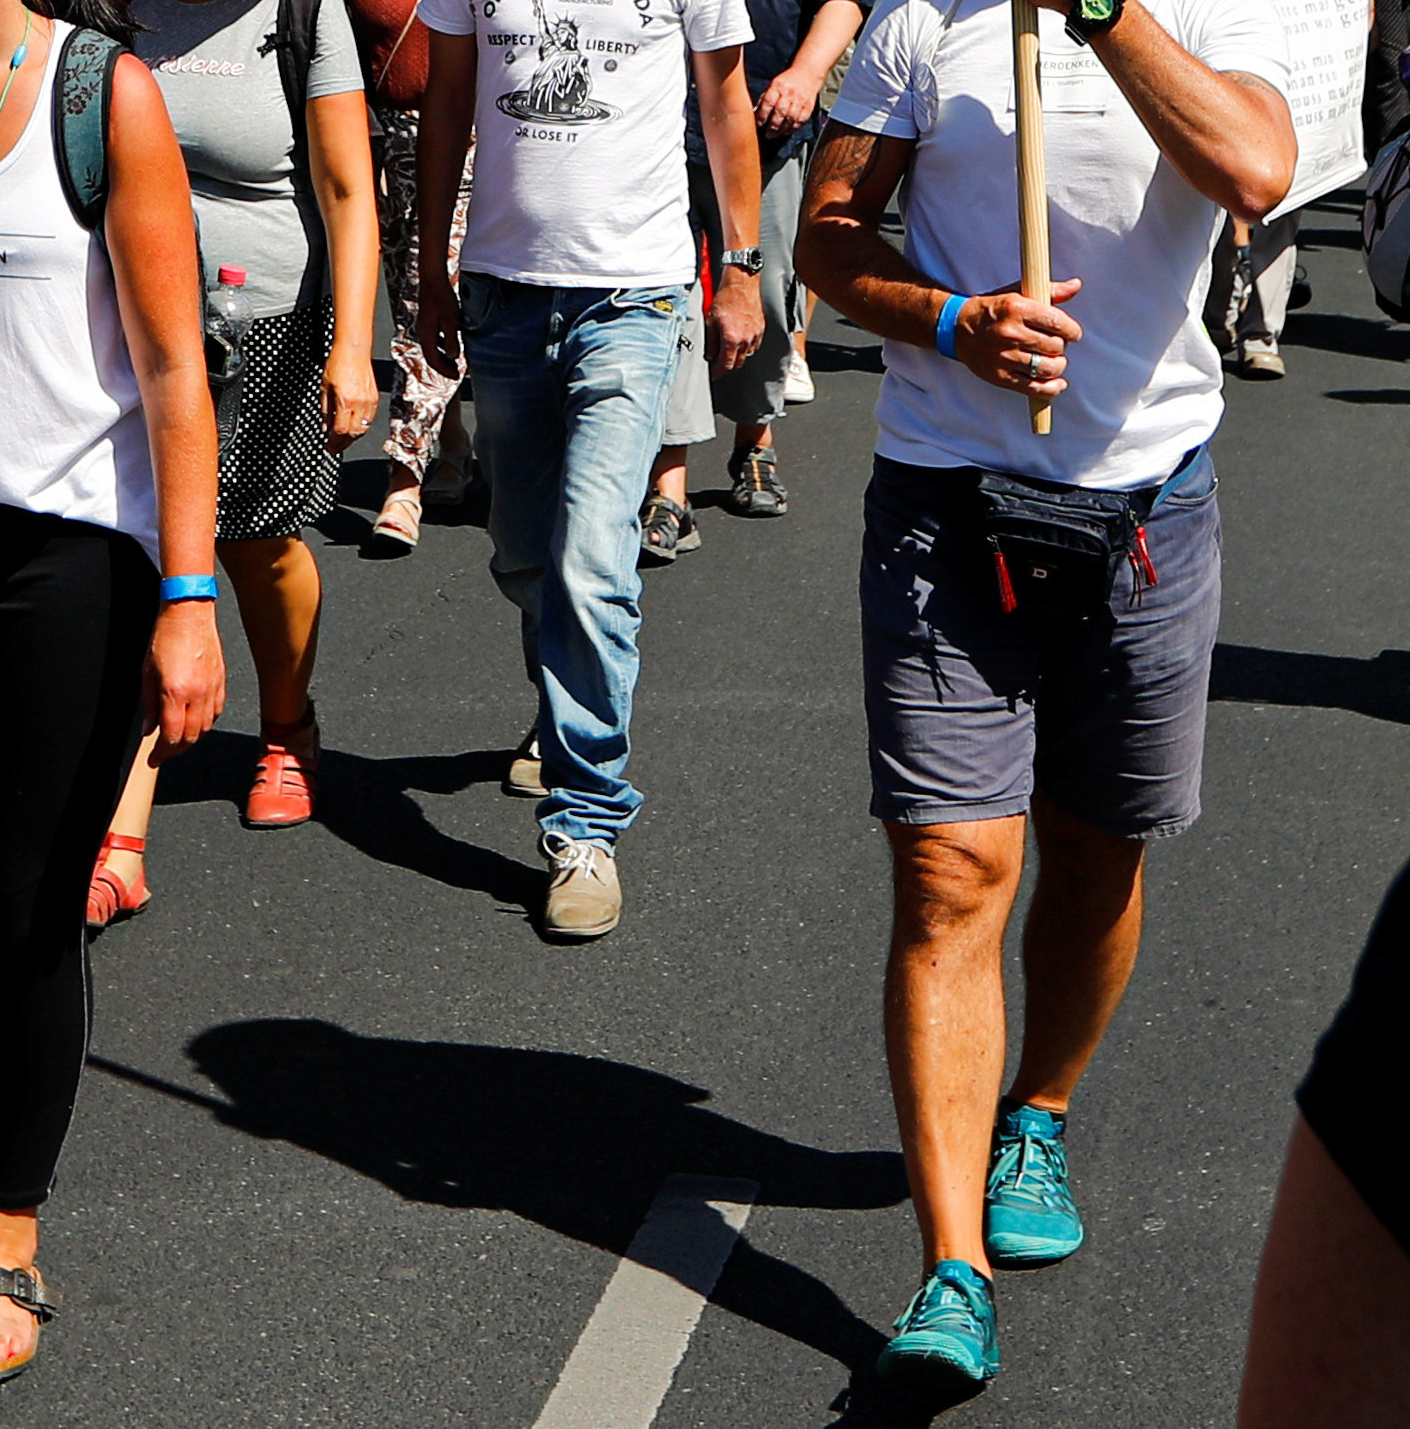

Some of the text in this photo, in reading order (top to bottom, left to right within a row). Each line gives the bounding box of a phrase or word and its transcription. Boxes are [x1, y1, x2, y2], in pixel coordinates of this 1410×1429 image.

[488, 33, 641, 55] RESPECT LIBERTY
[1043, 59, 1100, 71] ERDENKEN
[1290, 93, 1323, 110] muss
[1294, 110, 1324, 128] muss
[515, 125, 580, 142] OR LOSE IT
